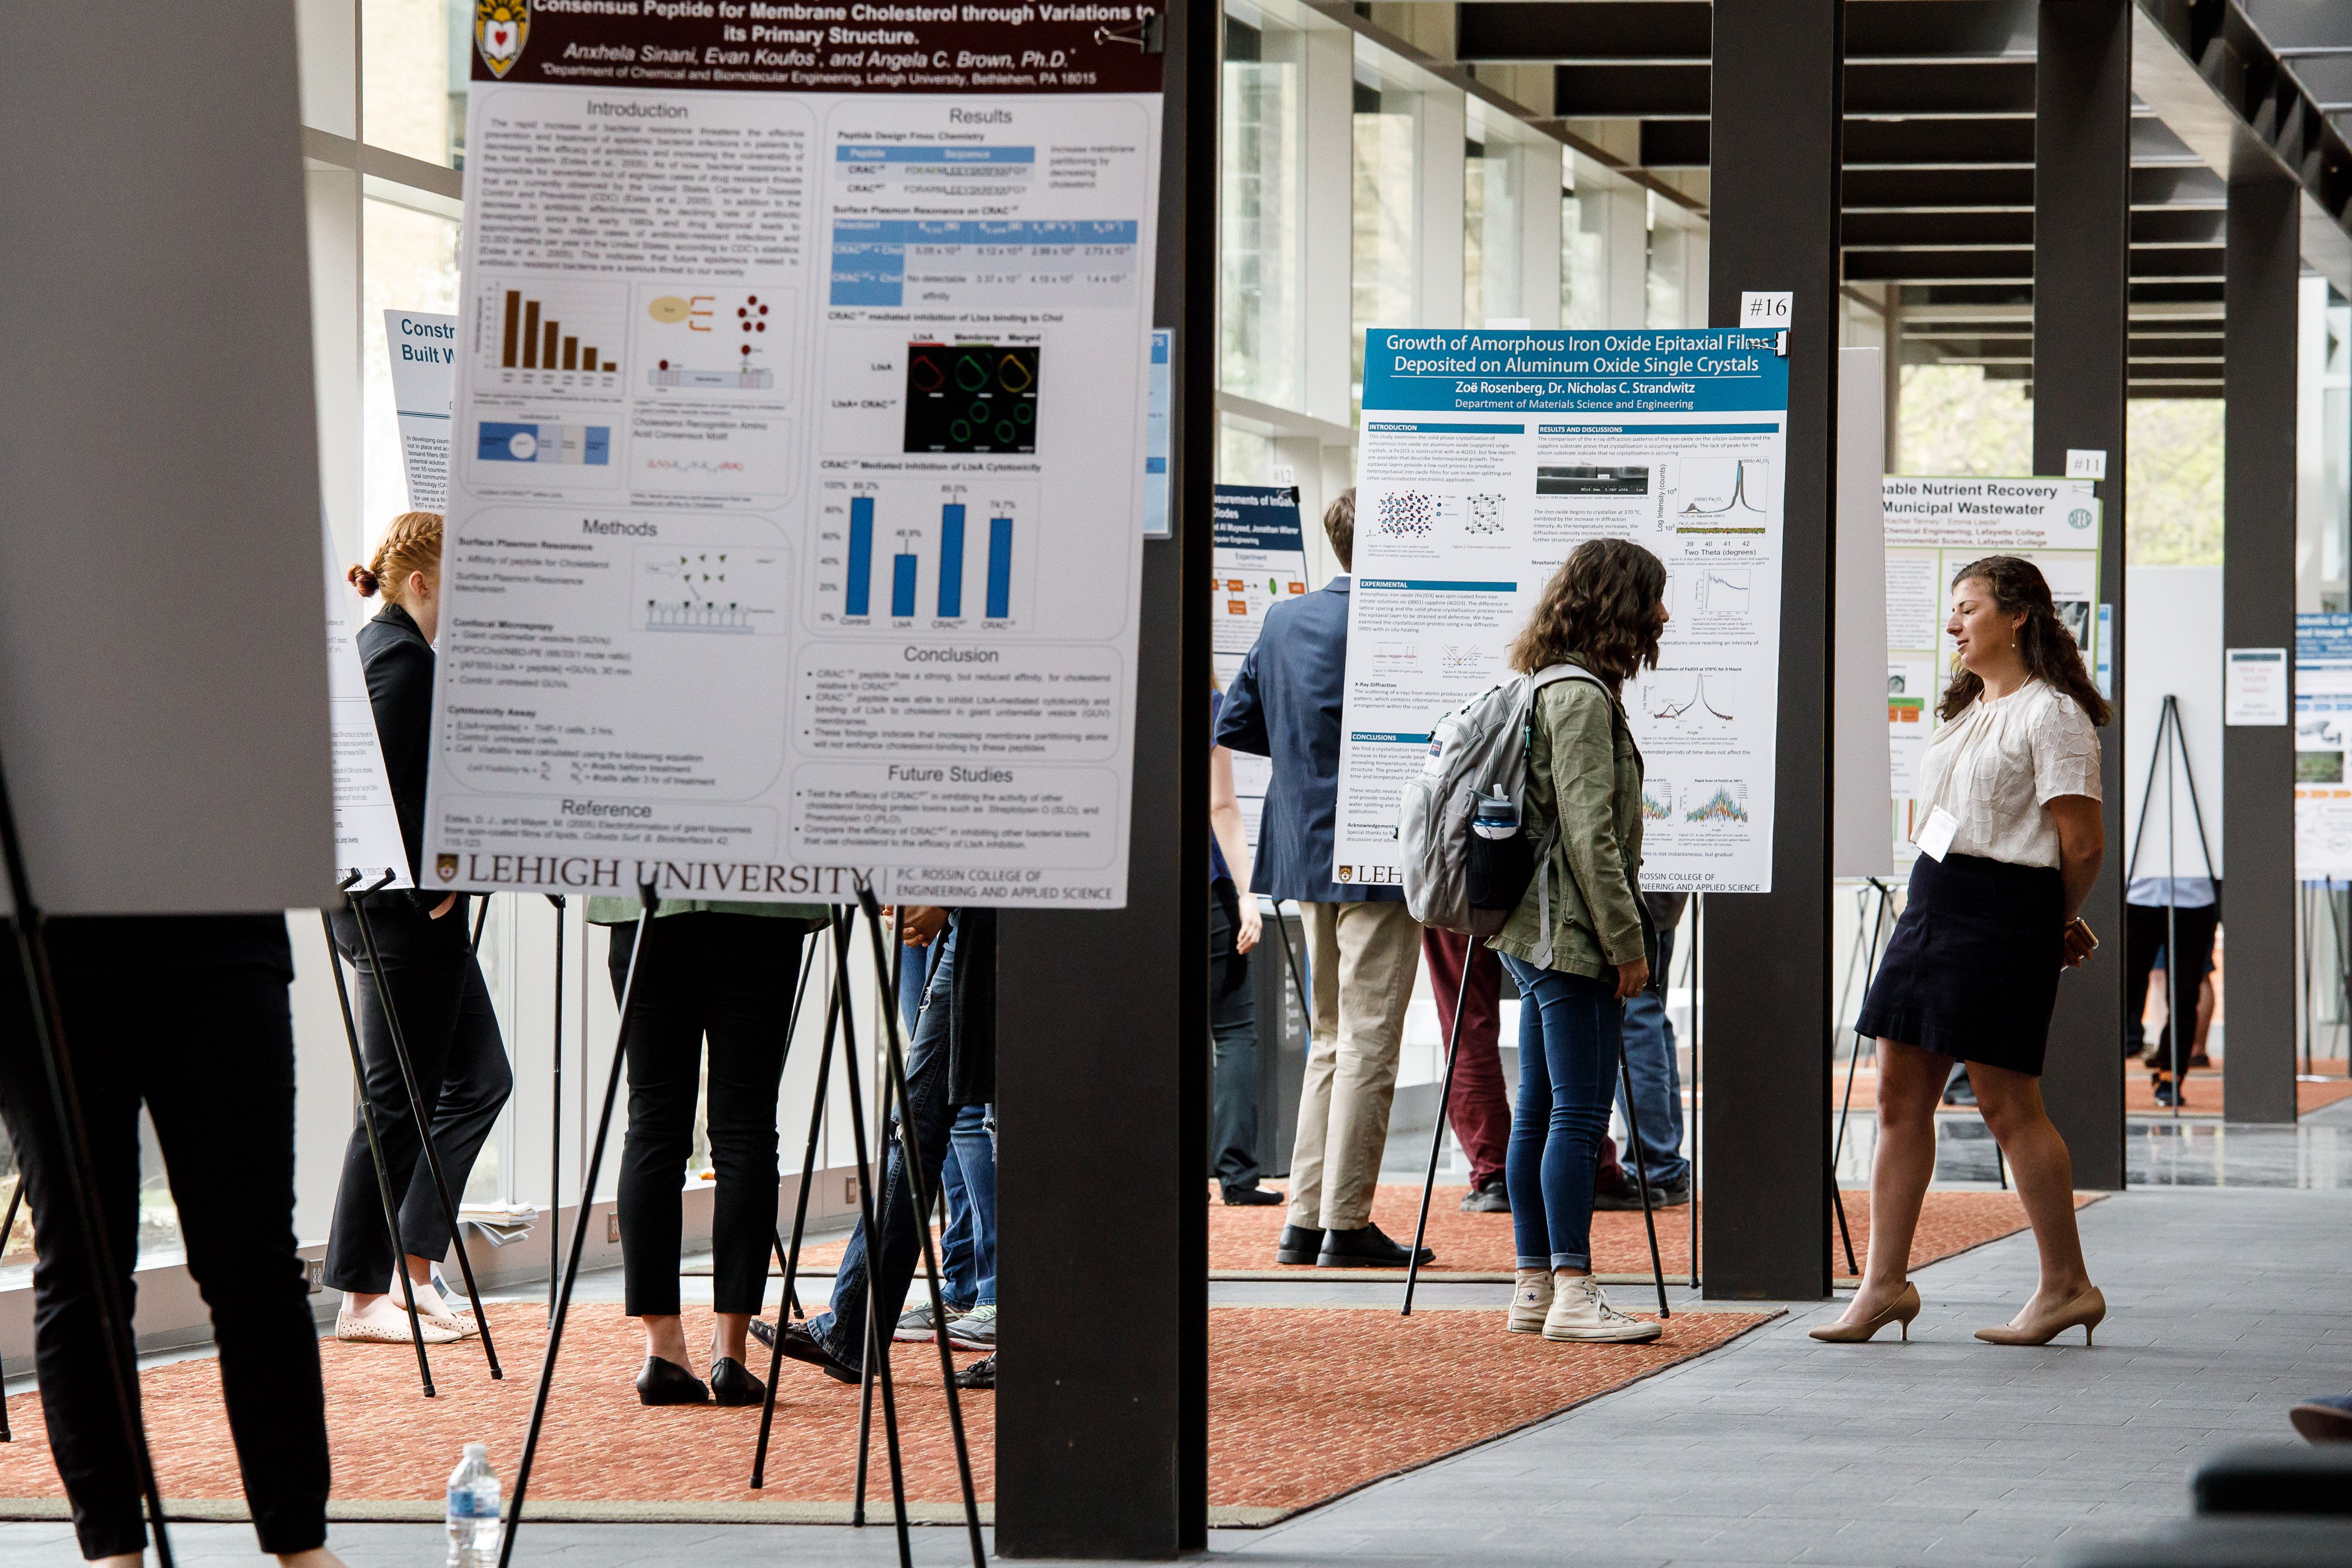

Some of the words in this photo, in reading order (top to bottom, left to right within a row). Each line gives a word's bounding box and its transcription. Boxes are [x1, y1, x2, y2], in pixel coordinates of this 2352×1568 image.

[534, 0, 638, 15] Consensus
[644, 0, 714, 19] Peptide
[719, 1, 746, 19] for
[750, 2, 847, 21] Membrane
[851, 3, 957, 21] Cholesterol
[962, 5, 1034, 24] through
[1039, 4, 1131, 21] Variations
[1137, 4, 1155, 24] to
[724, 25, 746, 42] its
[752, 25, 824, 47] Primary
[829, 26, 919, 45] Structure.
[563, 42, 636, 61] Anxhela
[640, 45, 699, 65] Sinani,
[704, 47, 750, 65] Evan
[830, 51, 864, 68] and
[867, 50, 928, 71] Angela
[933, 51, 950, 68] C.
[956, 51, 1015, 69] Brown,
[587, 100, 689, 118] Introduction
[950, 107, 1013, 124] Results
[1750, 299, 1786, 316] #16
[402, 344, 439, 363] Built
[1387, 335, 1446, 350] Growth
[1451, 335, 1468, 350] of
[1471, 335, 1564, 355] Amorphous
[1569, 336, 1599, 351] Iron
[1605, 336, 1651, 351] Oxide
[1656, 335, 1722, 354] Epitaxial
[1727, 334, 1769, 350] Films
[1395, 356, 1476, 375] Deposited
[1481, 360, 1500, 372] on
[1505, 356, 1588, 372] Aluminum
[1593, 357, 1639, 373] Oxide
[1644, 357, 1693, 376] Single
[1698, 356, 1758, 375] Crystals
[1456, 382, 1478, 393] Zoë
[1481, 381, 1545, 396] Rosenberg,
[1549, 382, 1565, 394] Dr.
[1568, 382, 1616, 393] Nicholas
[1619, 382, 1629, 394] C.
[1633, 381, 1695, 394] Strandwitz
[1455, 399, 1514, 410] Department
[1516, 399, 1526, 408] of
[1529, 399, 1574, 409] Materials
[1577, 399, 1613, 408] Science
[1616, 399, 1633, 409] and
[1637, 399, 1693, 410] Engineering
[2074, 459, 2099, 472] #11
[1659, 464, 1667, 490] (counts)
[1923, 483, 1982, 496] Nutrient
[1987, 483, 2057, 499] Recovery
[1657, 492, 1666, 520] Intensity
[1884, 502, 1952, 516] Municipal
[1958, 502, 2044, 514] Wastewater
[582, 519, 658, 537] Methods
[1656, 520, 1665, 532] Log
[1923, 527, 1972, 537] Engineering,
[1976, 528, 2012, 536] Lafayette
[2015, 529, 2045, 537] College
[1942, 538, 1975, 547] Science,
[1978, 538, 2014, 548] Lafayette
[2017, 539, 2047, 549] College
[904, 644, 1002, 663] Conclusion
[888, 764, 944, 782] Future
[950, 765, 1013, 783] Studies
[561, 798, 652, 820] Reference
[469, 854, 620, 888] LEHIGH
[637, 859, 873, 894] UNIVERSITY
[894, 866, 917, 881] P.C.
[921, 866, 965, 881] ROSSIN
[968, 869, 1021, 882] COLLEGE
[1025, 868, 1044, 882] OF
[896, 884, 977, 898] ENGINEERING
[980, 886, 1008, 898] AND
[1011, 886, 1059, 900] APPLIED
[1063, 887, 1111, 900] SCIENCE
